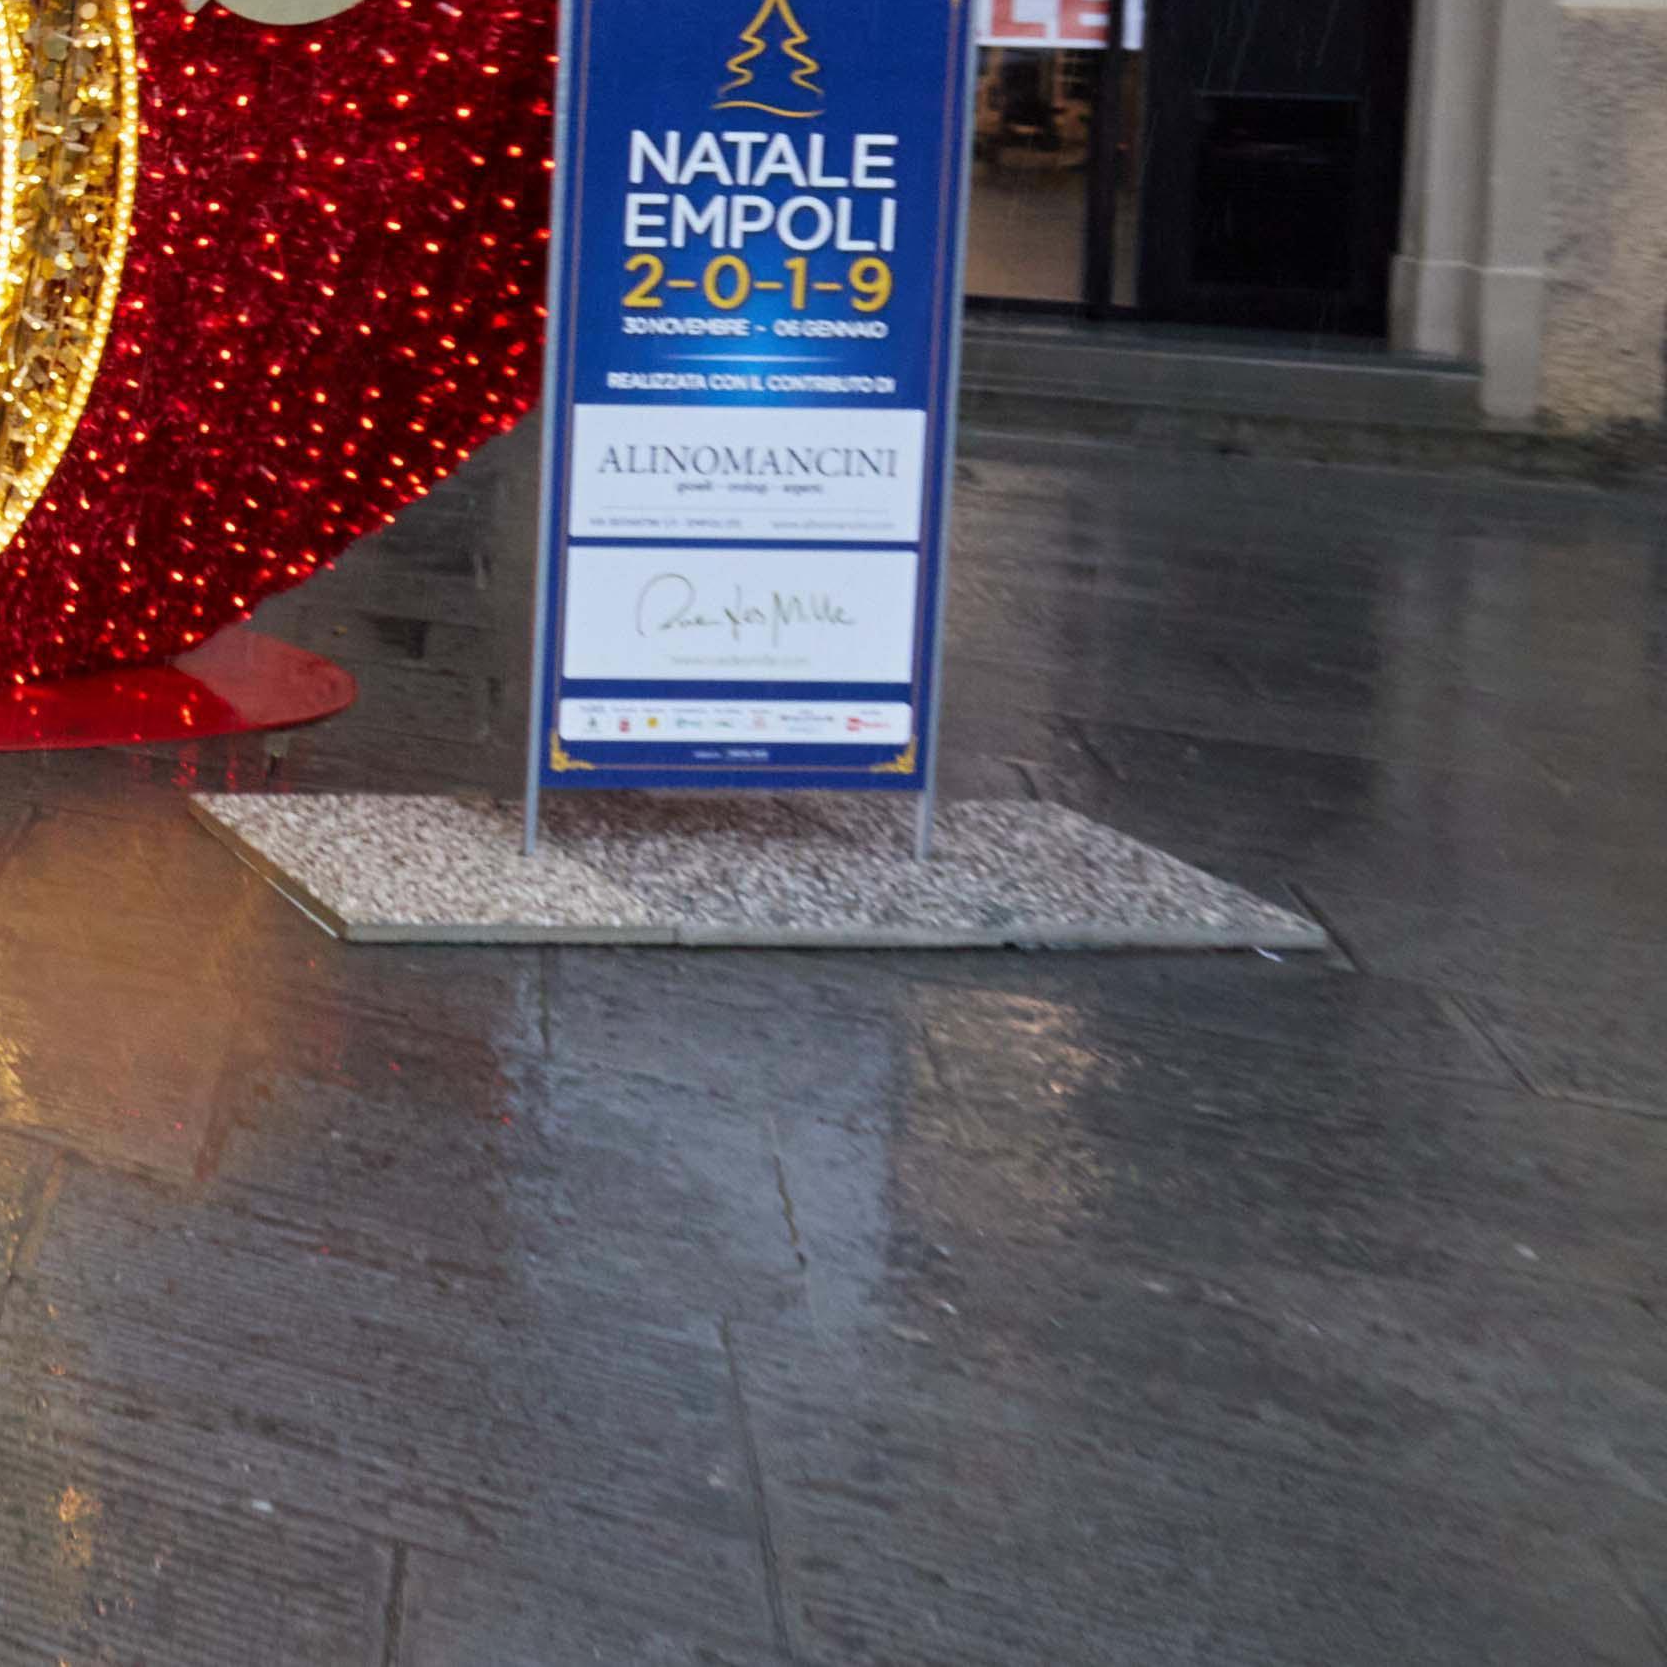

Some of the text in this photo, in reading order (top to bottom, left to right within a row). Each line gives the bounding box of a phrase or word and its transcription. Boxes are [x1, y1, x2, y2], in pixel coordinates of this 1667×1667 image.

[628, 130, 899, 188] NATALE
[623, 193, 898, 251] EMPOLI
[622, 253, 893, 312] 2-0-1-9
[648, 316, 751, 336] NOVEMBRE
[802, 319, 889, 339] GENNAIO
[606, 371, 707, 390] REALIZZATA
[708, 372, 748, 391] CON
[766, 374, 873, 393] CONTRIBUTO
[597, 444, 898, 479] ALINOMANCINI
